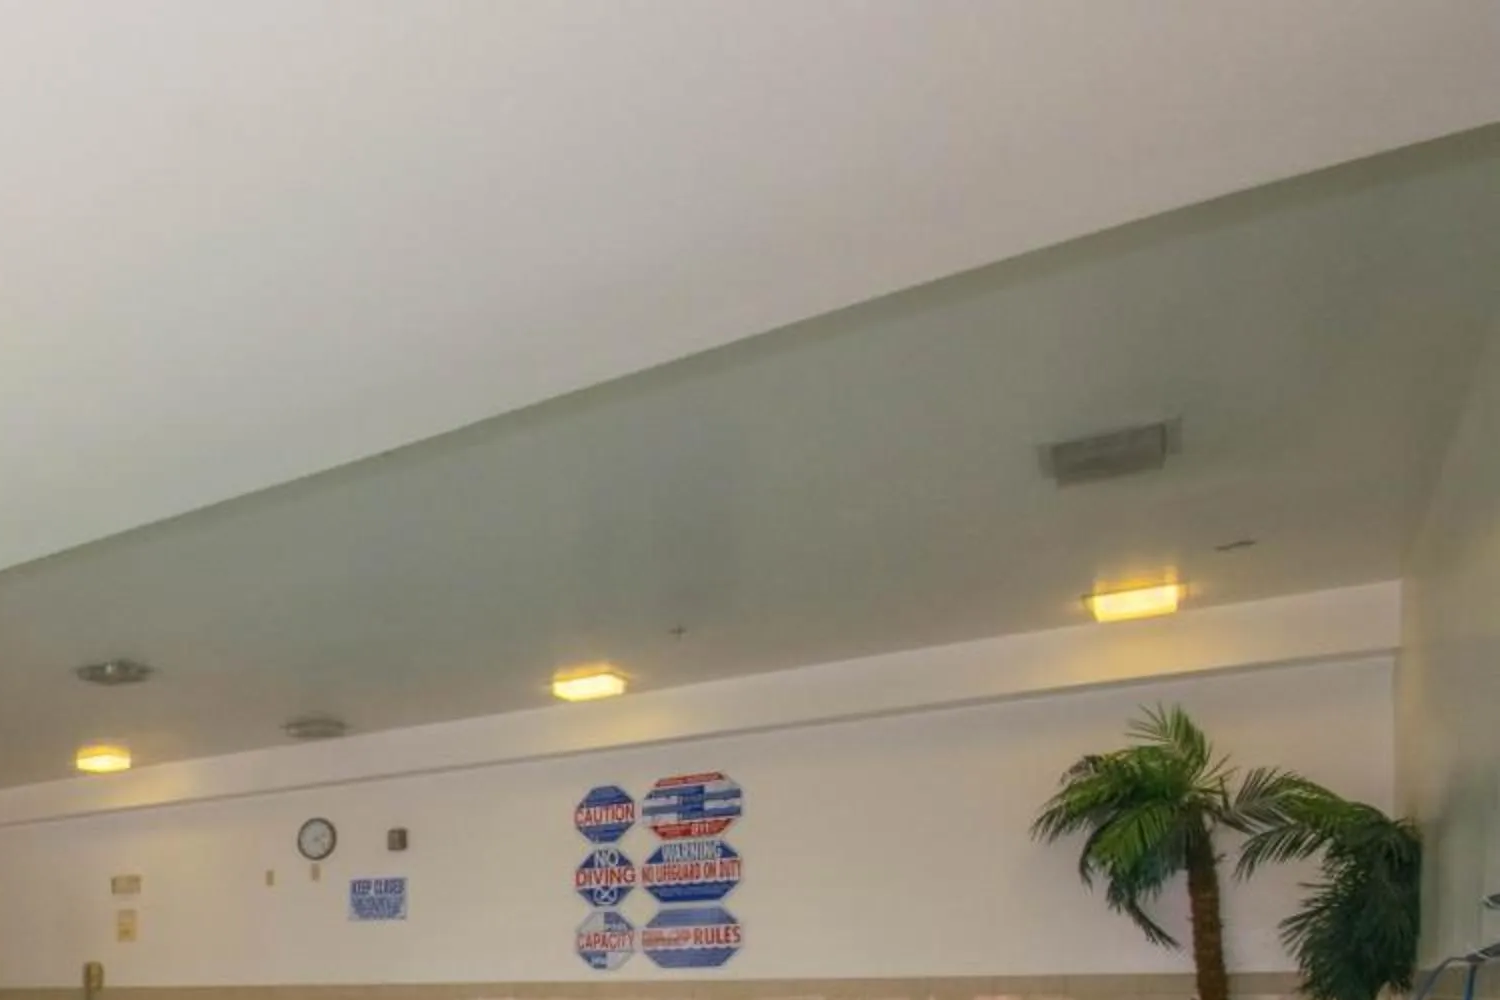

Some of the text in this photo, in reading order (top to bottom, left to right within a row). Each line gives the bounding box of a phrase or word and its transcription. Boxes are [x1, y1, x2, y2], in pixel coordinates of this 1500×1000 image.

[574, 803, 635, 825] CAUTION
[594, 849, 618, 868] NO
[662, 840, 722, 862] WARNING
[575, 866, 637, 887] DIVING
[642, 866, 655, 884] NO
[656, 862, 702, 882] LIFEGUARD
[704, 861, 717, 879] ON
[577, 929, 635, 950] CAPACITY
[693, 925, 741, 946] RULES
